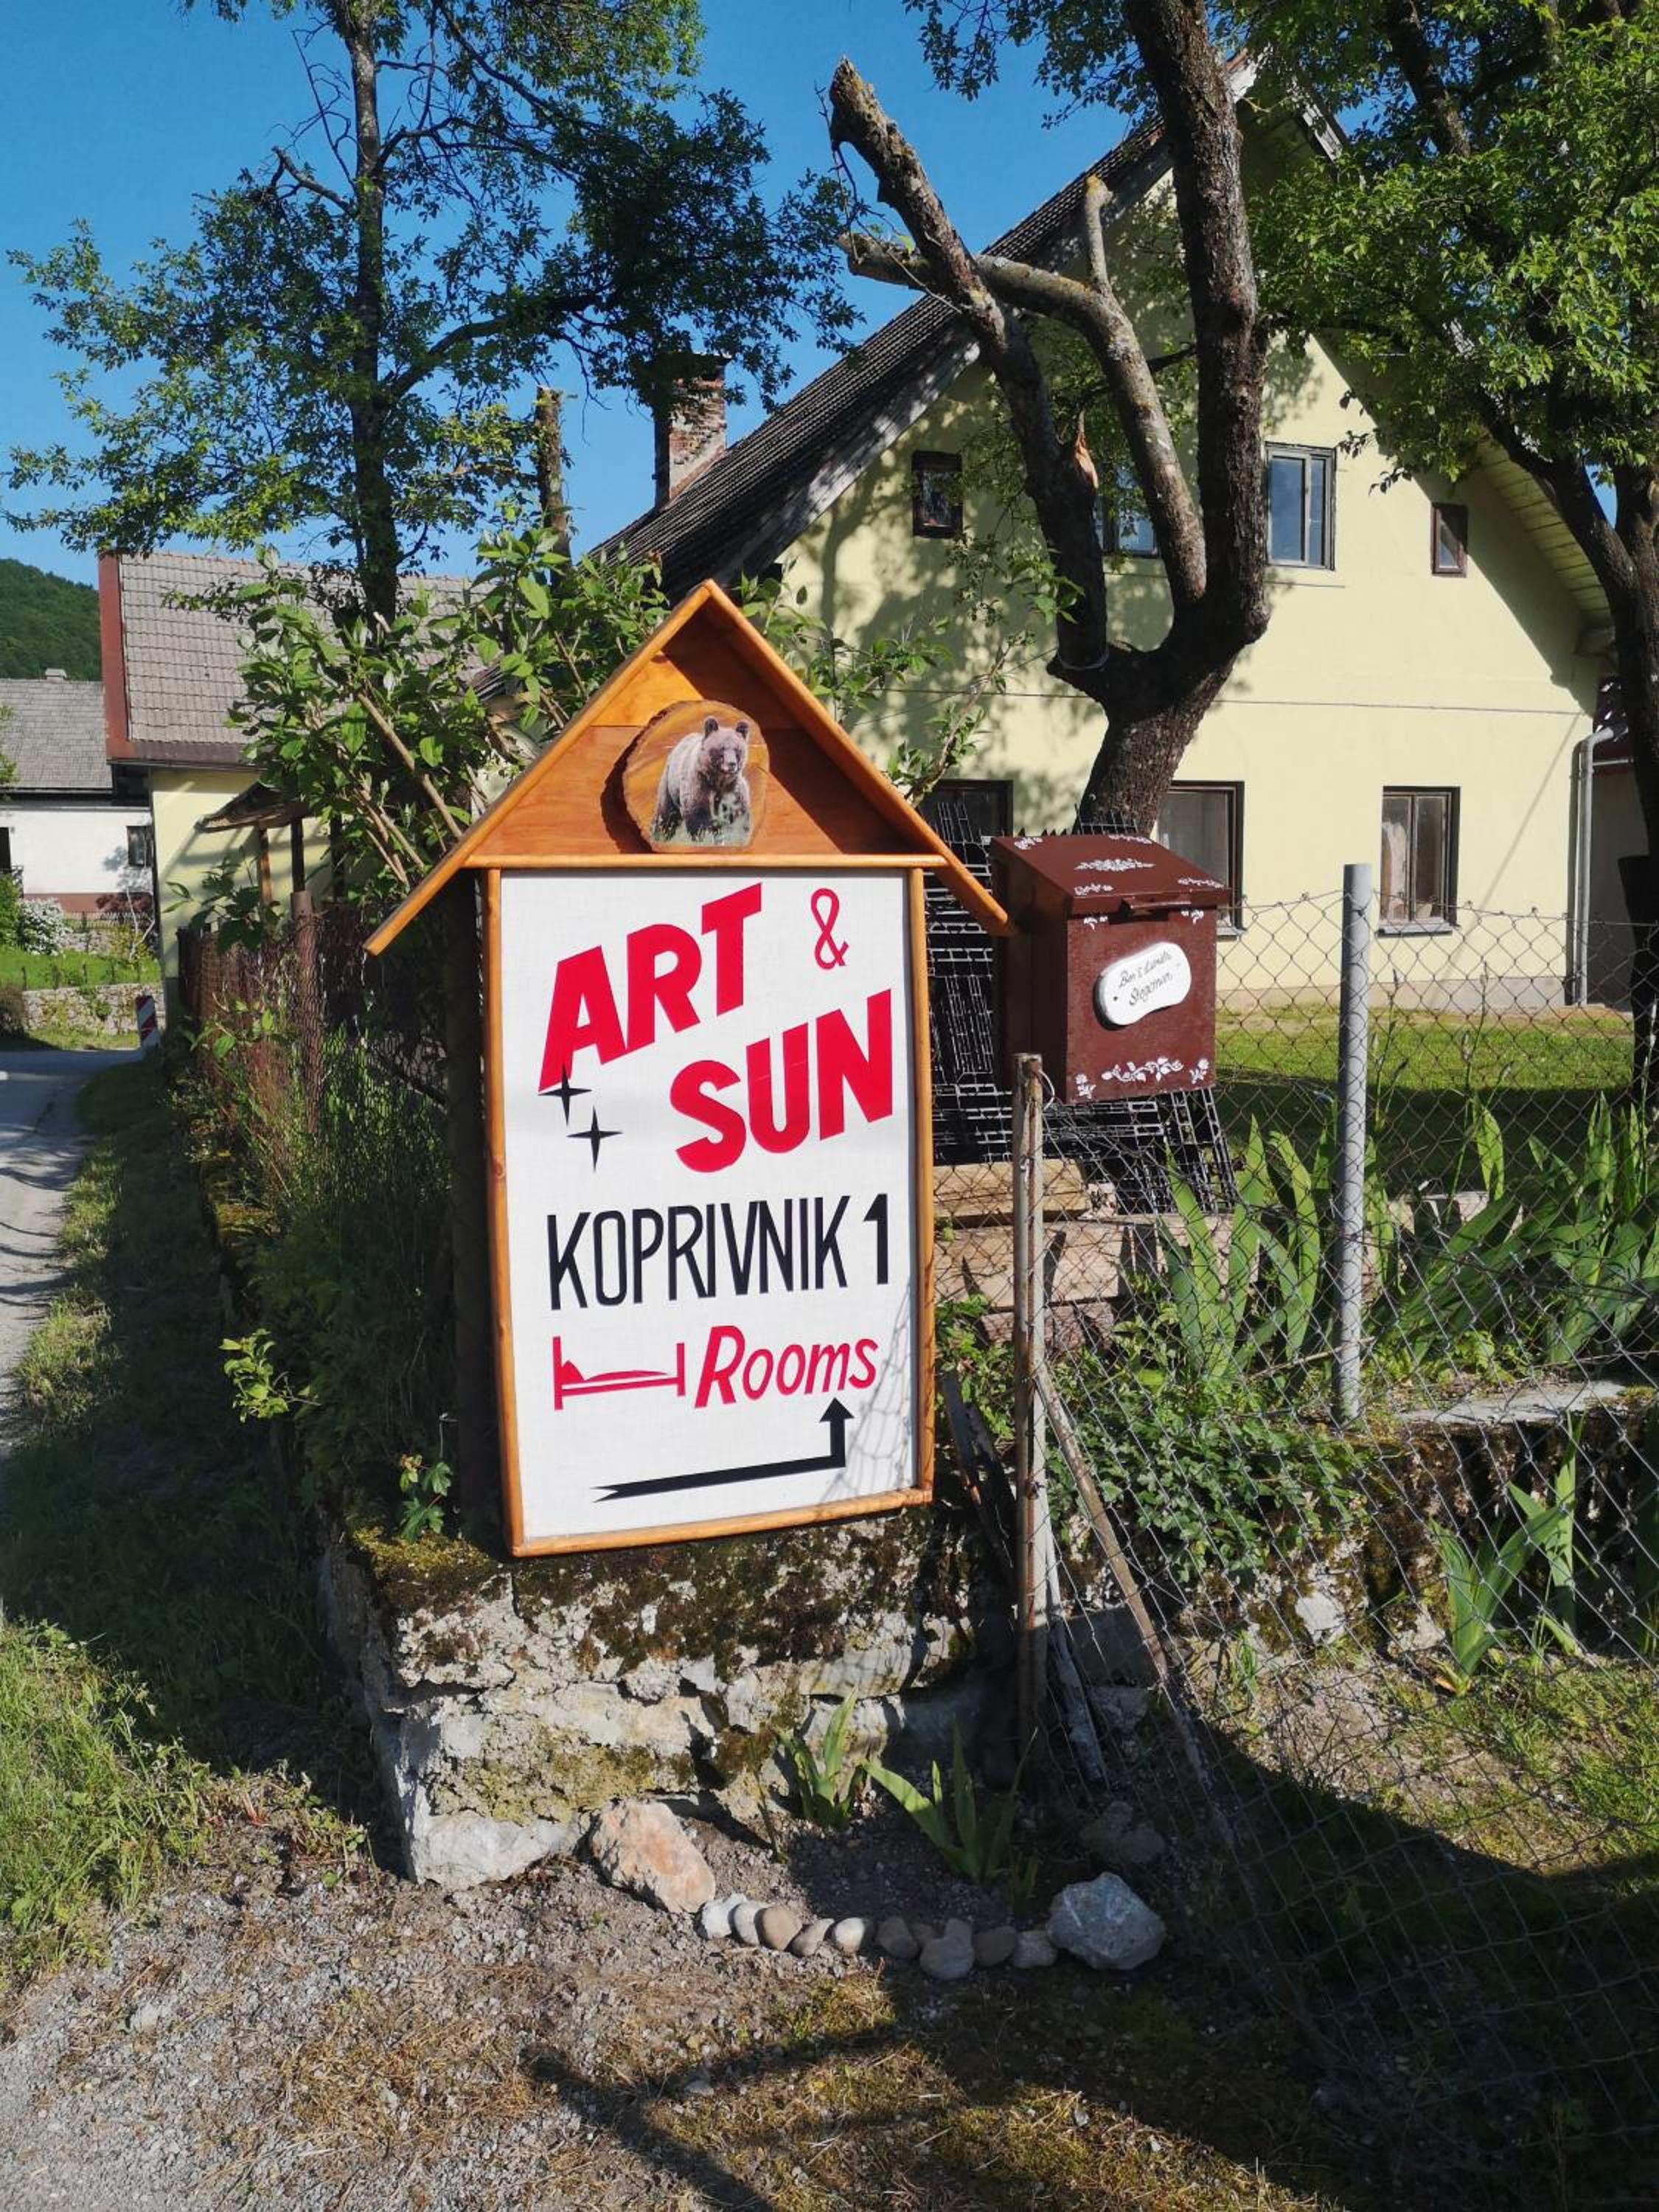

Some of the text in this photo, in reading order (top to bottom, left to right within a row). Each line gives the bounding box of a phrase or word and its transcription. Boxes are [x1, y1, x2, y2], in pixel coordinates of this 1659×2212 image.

[538, 883, 849, 1092] ART &
[669, 989, 893, 1173] SUN
[547, 1194, 888, 1310] KOPRIVNIK 1
[695, 1325, 878, 1408] Rooms
